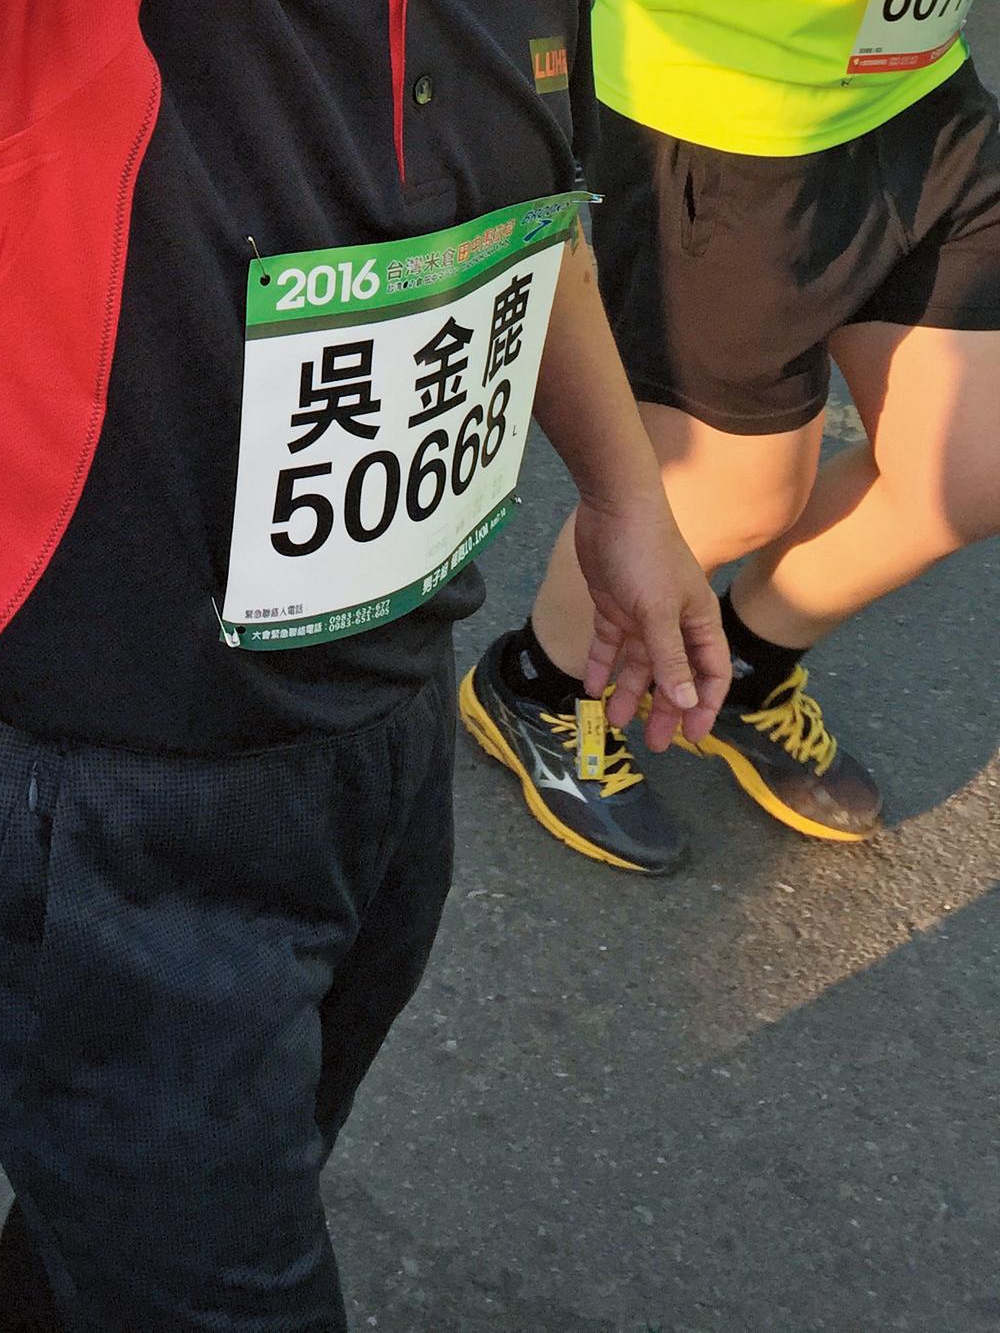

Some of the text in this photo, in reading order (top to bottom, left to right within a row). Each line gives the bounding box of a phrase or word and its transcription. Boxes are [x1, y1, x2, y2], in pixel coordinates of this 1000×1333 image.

[275, 259, 380, 311] 2016
[288, 272, 533, 454] 吳金鹿
[270, 380, 511, 559] 50668
